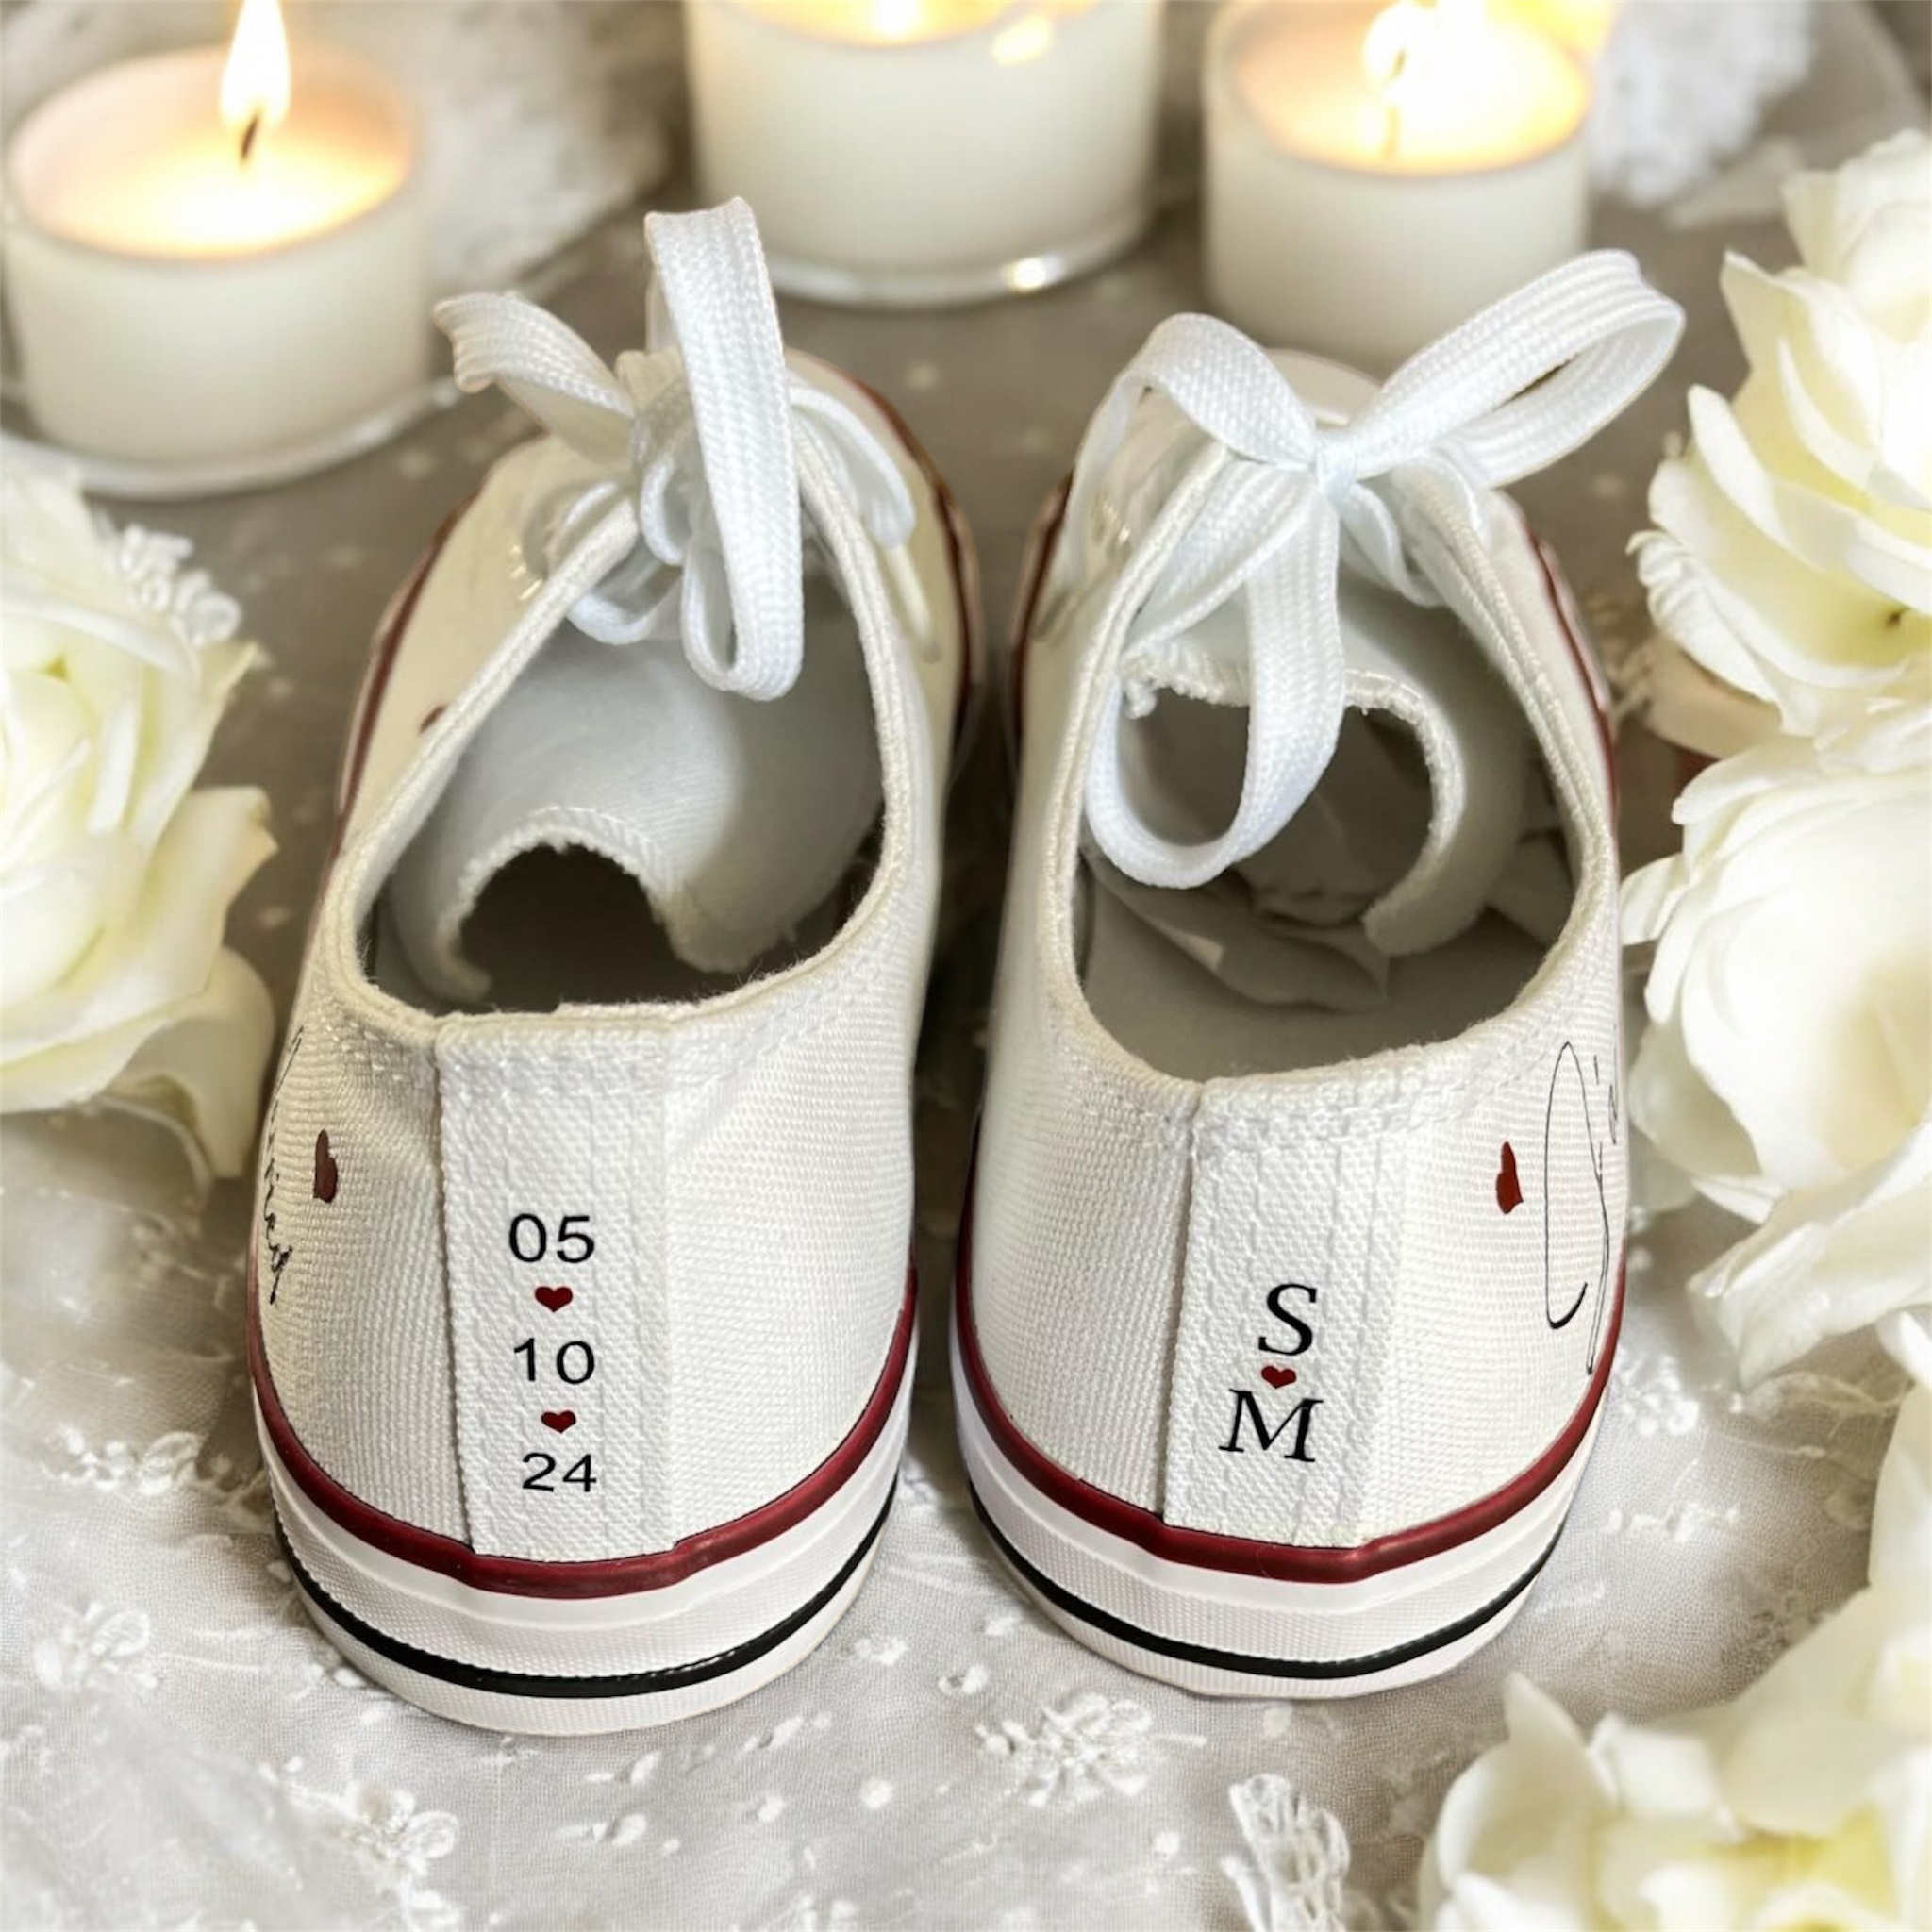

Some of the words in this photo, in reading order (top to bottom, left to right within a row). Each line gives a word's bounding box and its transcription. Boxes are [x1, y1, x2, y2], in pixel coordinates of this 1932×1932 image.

[509, 1213, 594, 1263] 05
[1258, 1283, 1317, 1356] S
[513, 1338, 595, 1384] 10
[1218, 1389, 1324, 1462] M
[523, 1453, 597, 1492] 24
